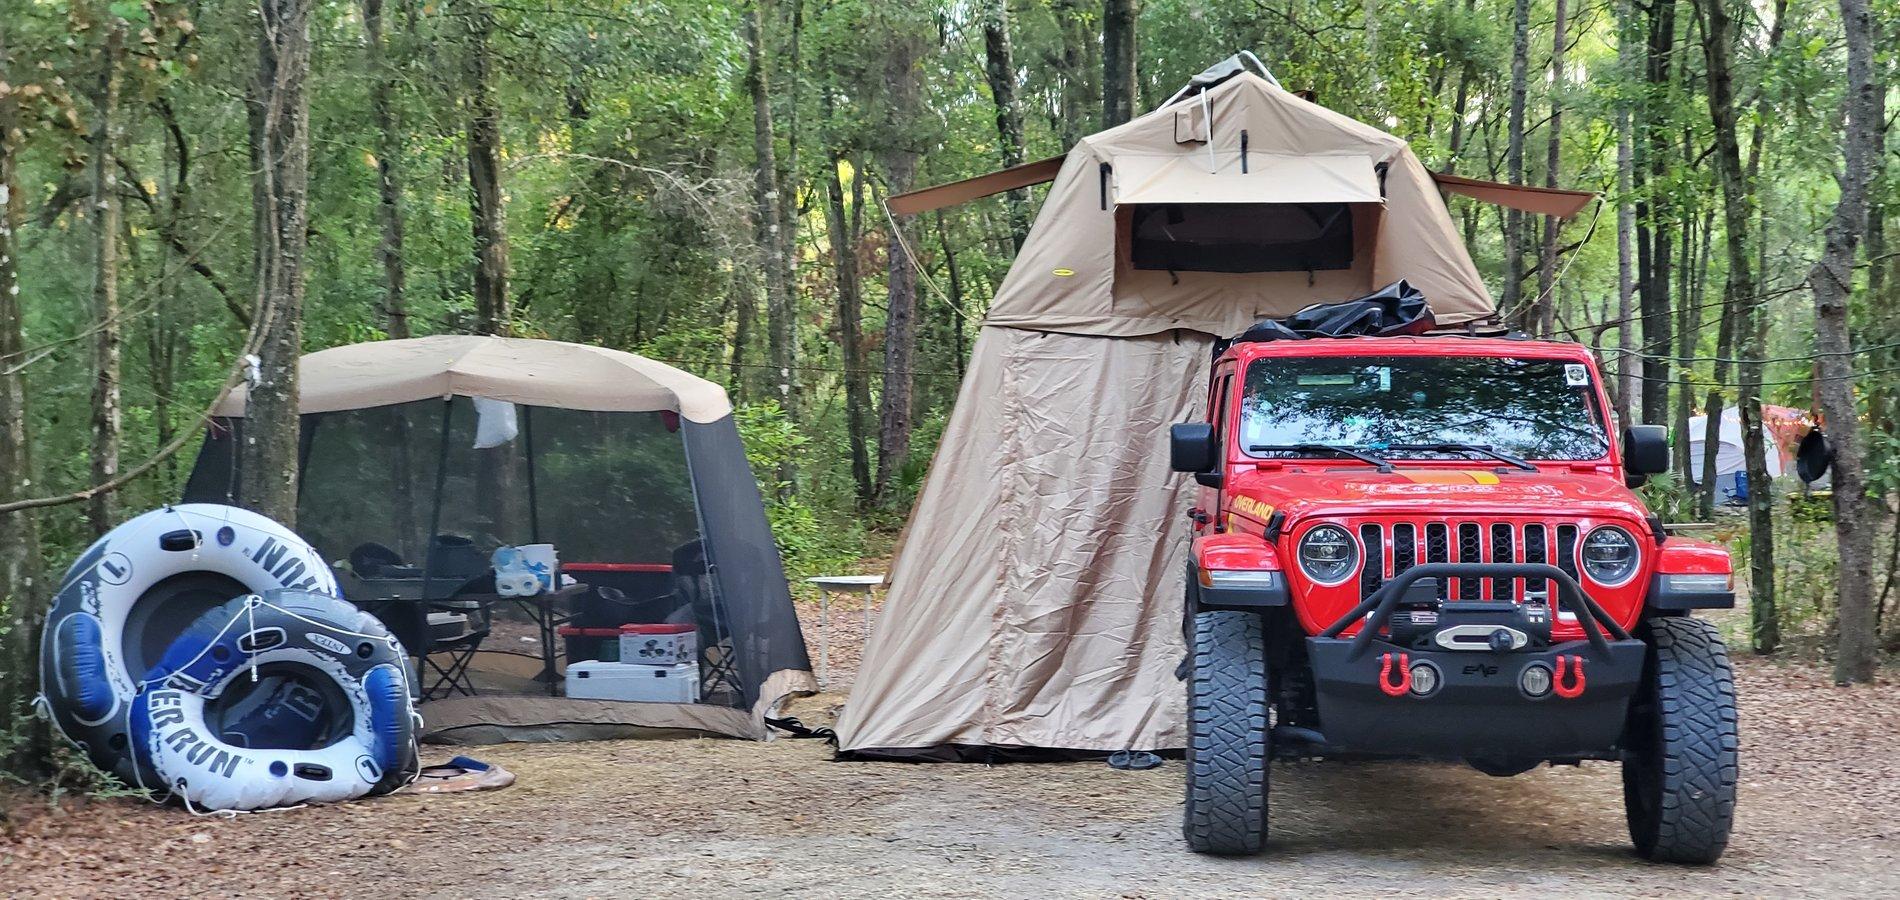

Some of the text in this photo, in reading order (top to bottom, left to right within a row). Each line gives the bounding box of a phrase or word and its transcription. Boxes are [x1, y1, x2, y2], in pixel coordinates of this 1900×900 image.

[1234, 494, 1274, 520] OVERLAND
[314, 634, 345, 652] INTEX
[164, 727, 242, 779] RUN
